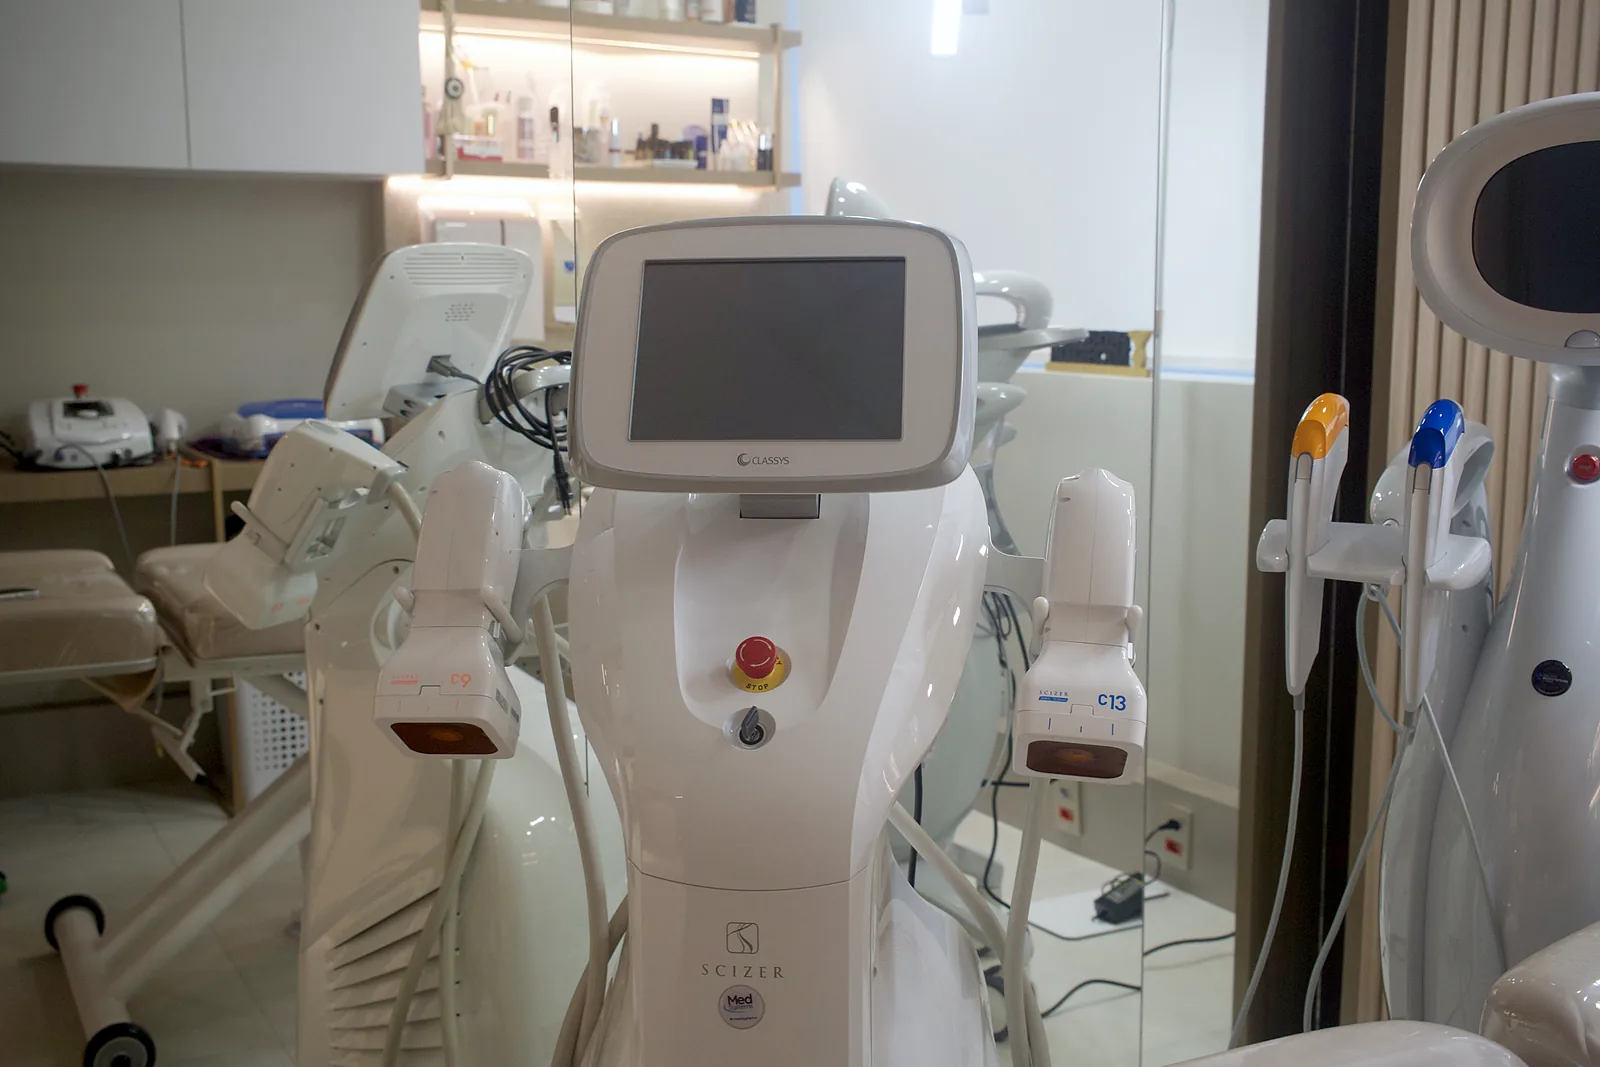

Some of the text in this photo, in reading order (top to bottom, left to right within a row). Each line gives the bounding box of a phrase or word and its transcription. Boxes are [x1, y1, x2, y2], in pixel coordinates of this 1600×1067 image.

[751, 456, 790, 465] CLASSYS
[450, 673, 472, 688] C9
[745, 683, 769, 691] STOP
[1098, 693, 1127, 711] C13
[701, 963, 785, 979] SCIZER
[727, 993, 753, 1005] Med
